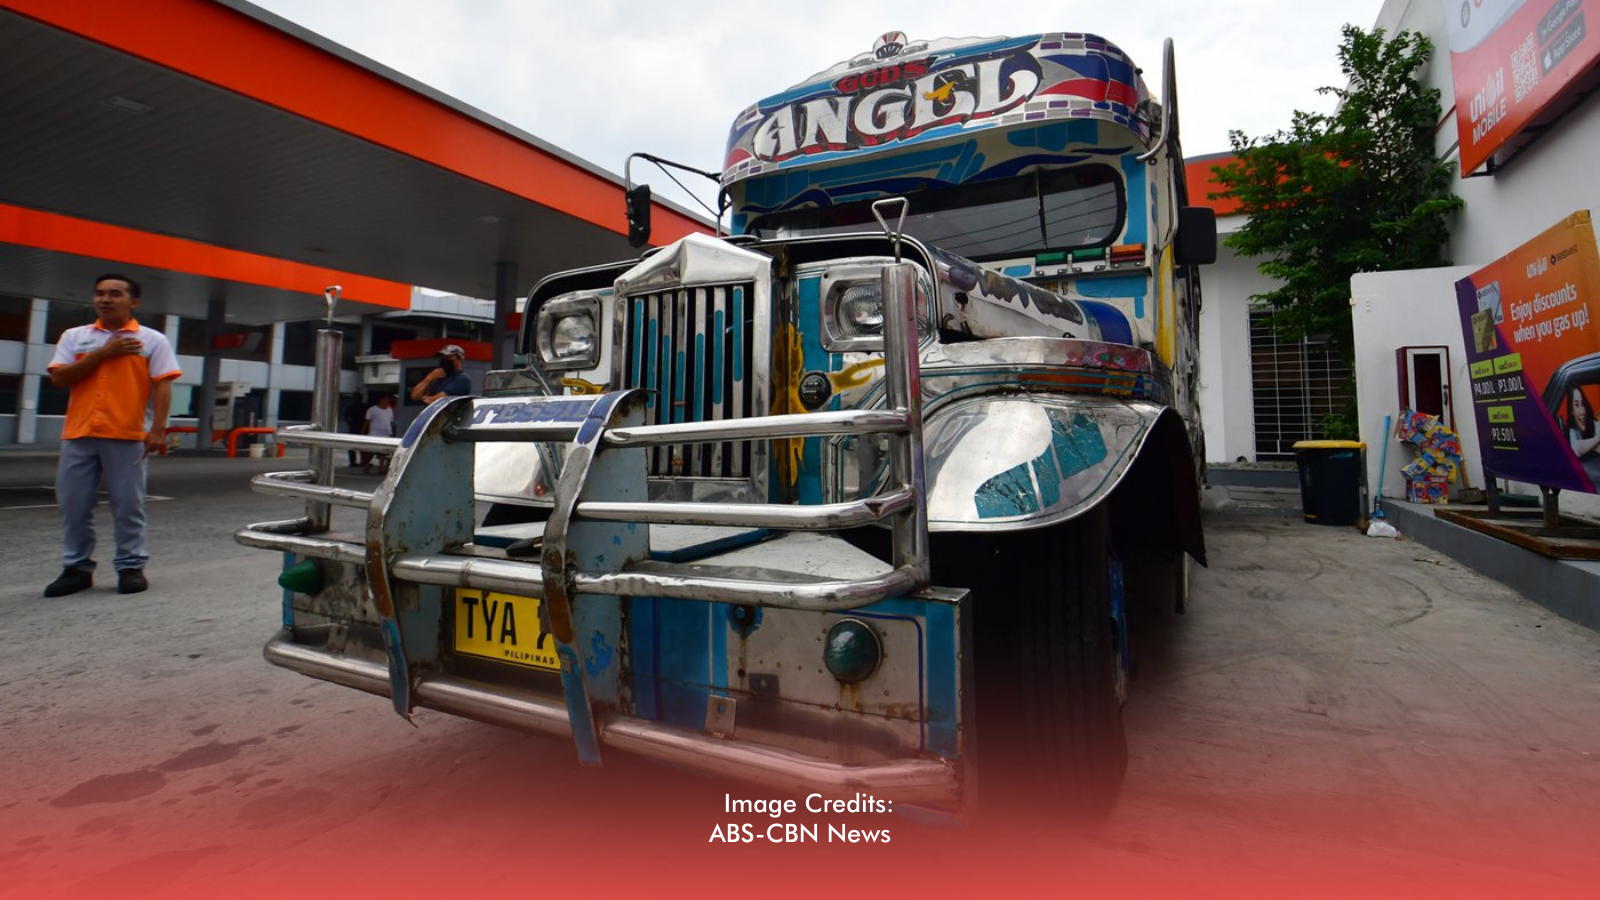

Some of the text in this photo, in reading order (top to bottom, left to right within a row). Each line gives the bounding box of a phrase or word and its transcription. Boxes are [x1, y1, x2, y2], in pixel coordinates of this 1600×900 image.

[752, 50, 1044, 161] ANGEL
[1473, 97, 1507, 146] MOBILE
[1510, 282, 1577, 323] Enjoy discounts
[1513, 302, 1590, 343] when you gas up!
[462, 597, 517, 646] TYA
[504, 649, 555, 665] PILIPINAS
